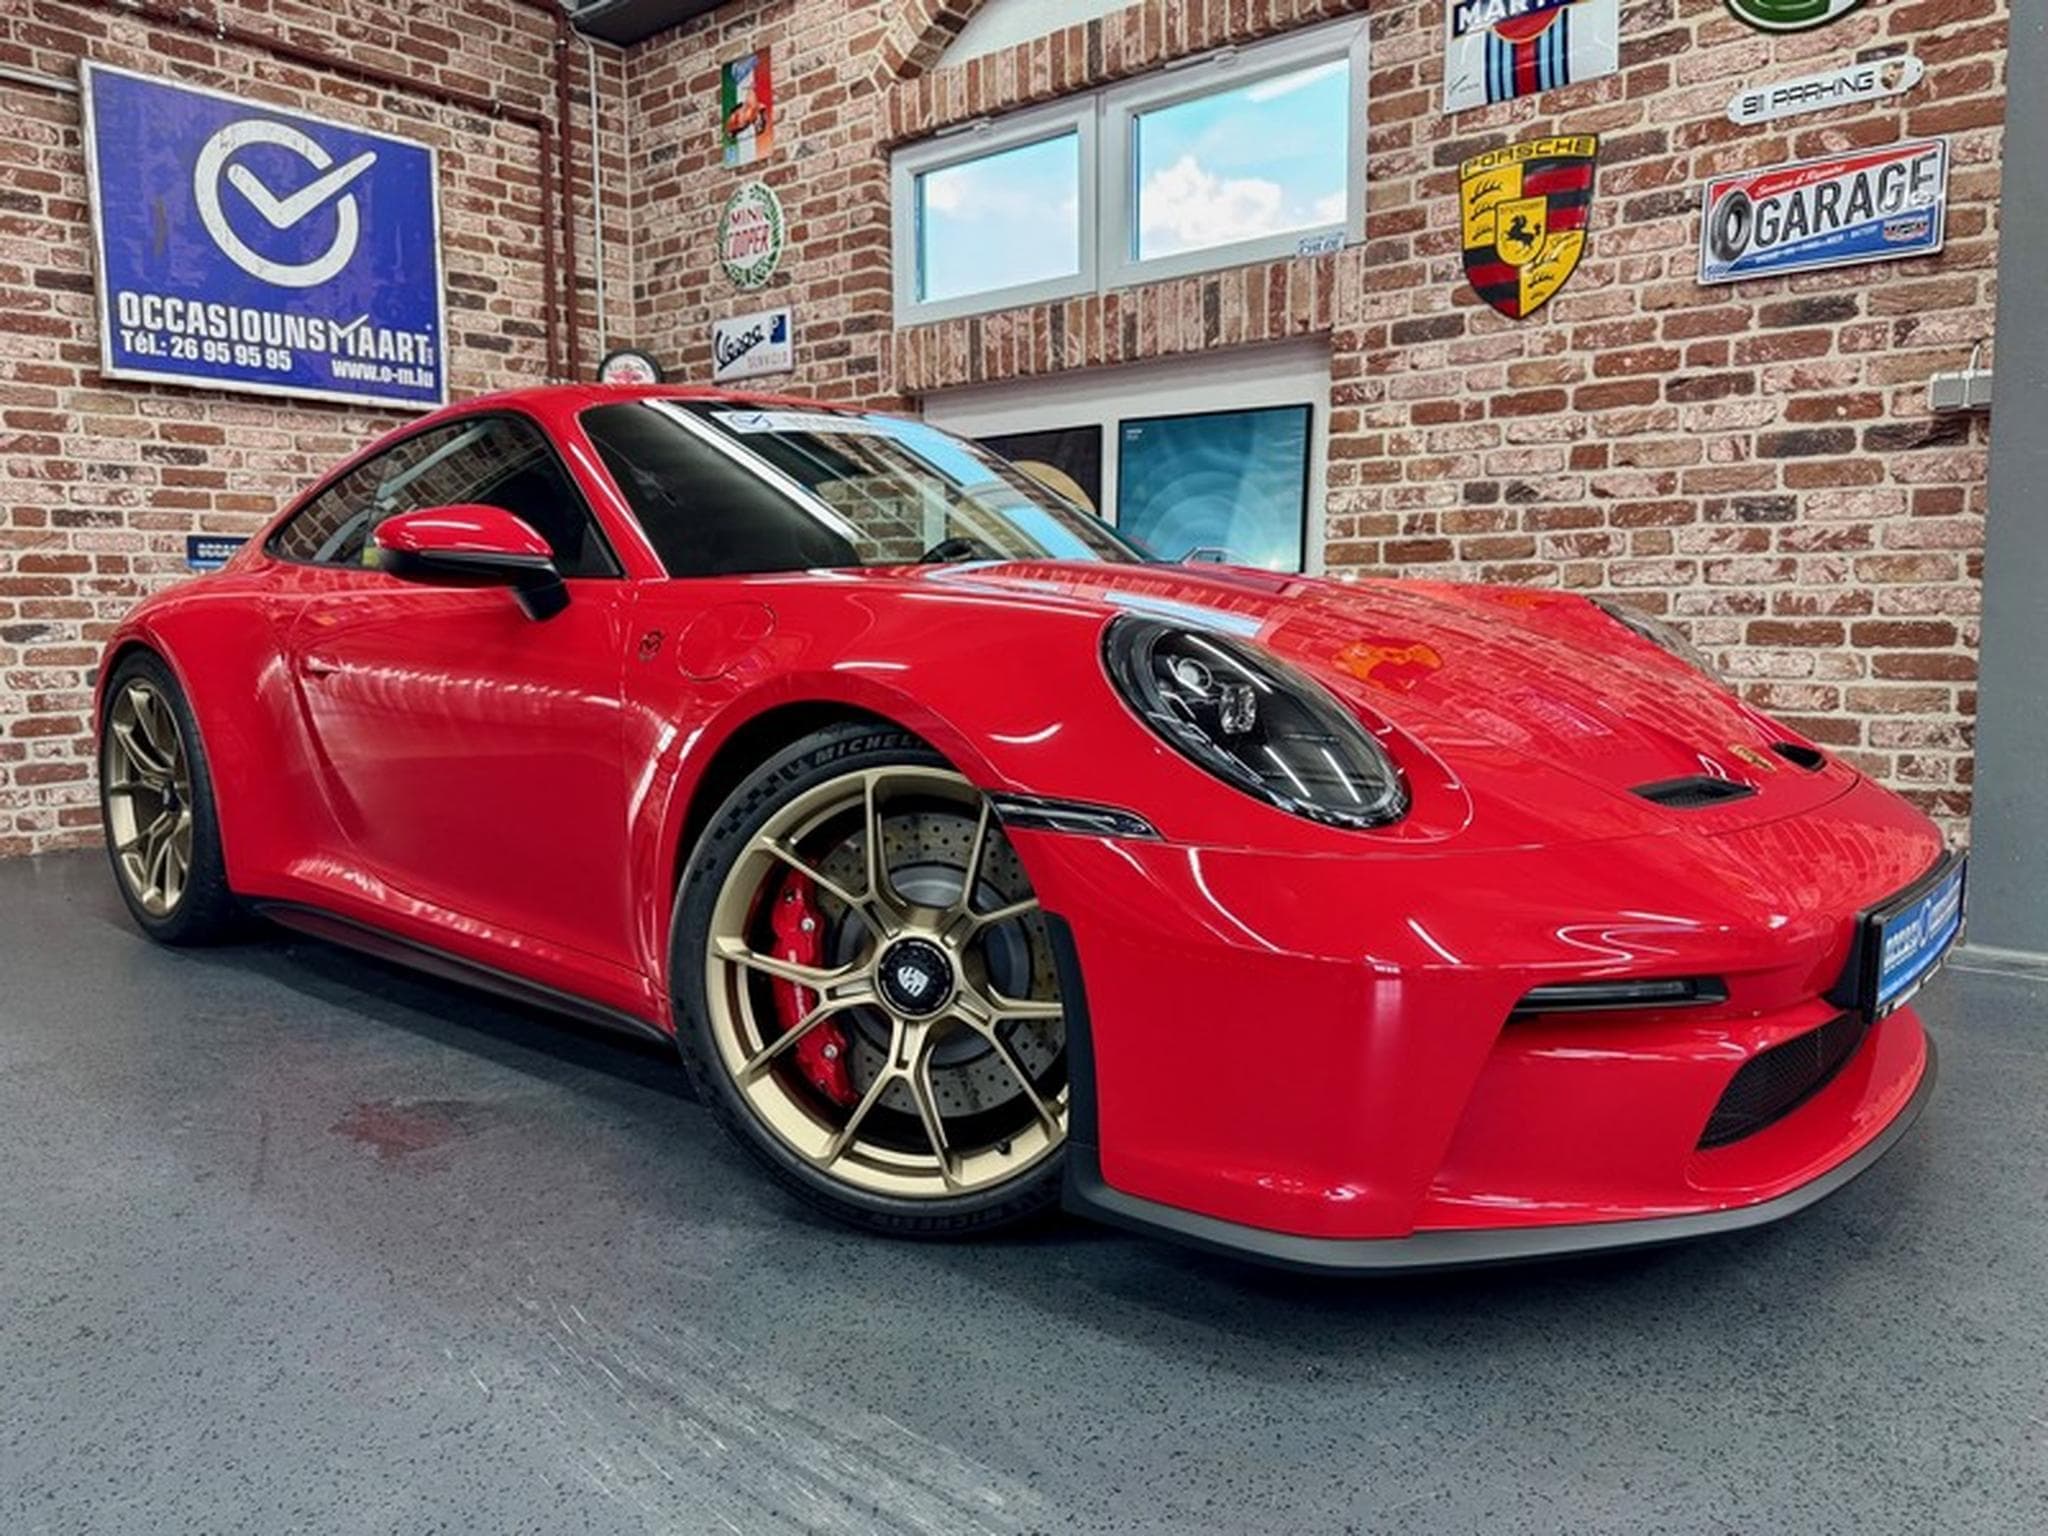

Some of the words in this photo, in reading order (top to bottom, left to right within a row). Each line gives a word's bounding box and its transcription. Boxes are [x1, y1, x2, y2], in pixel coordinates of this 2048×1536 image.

[1772, 71, 1873, 109] PARKING
[1464, 138, 1591, 175] PORSCHE
[1754, 152, 1938, 248] GARAGE
[171, 335, 198, 360] 26
[203, 340, 231, 364] 95
[234, 344, 262, 368] 95
[265, 347, 292, 372] 95
